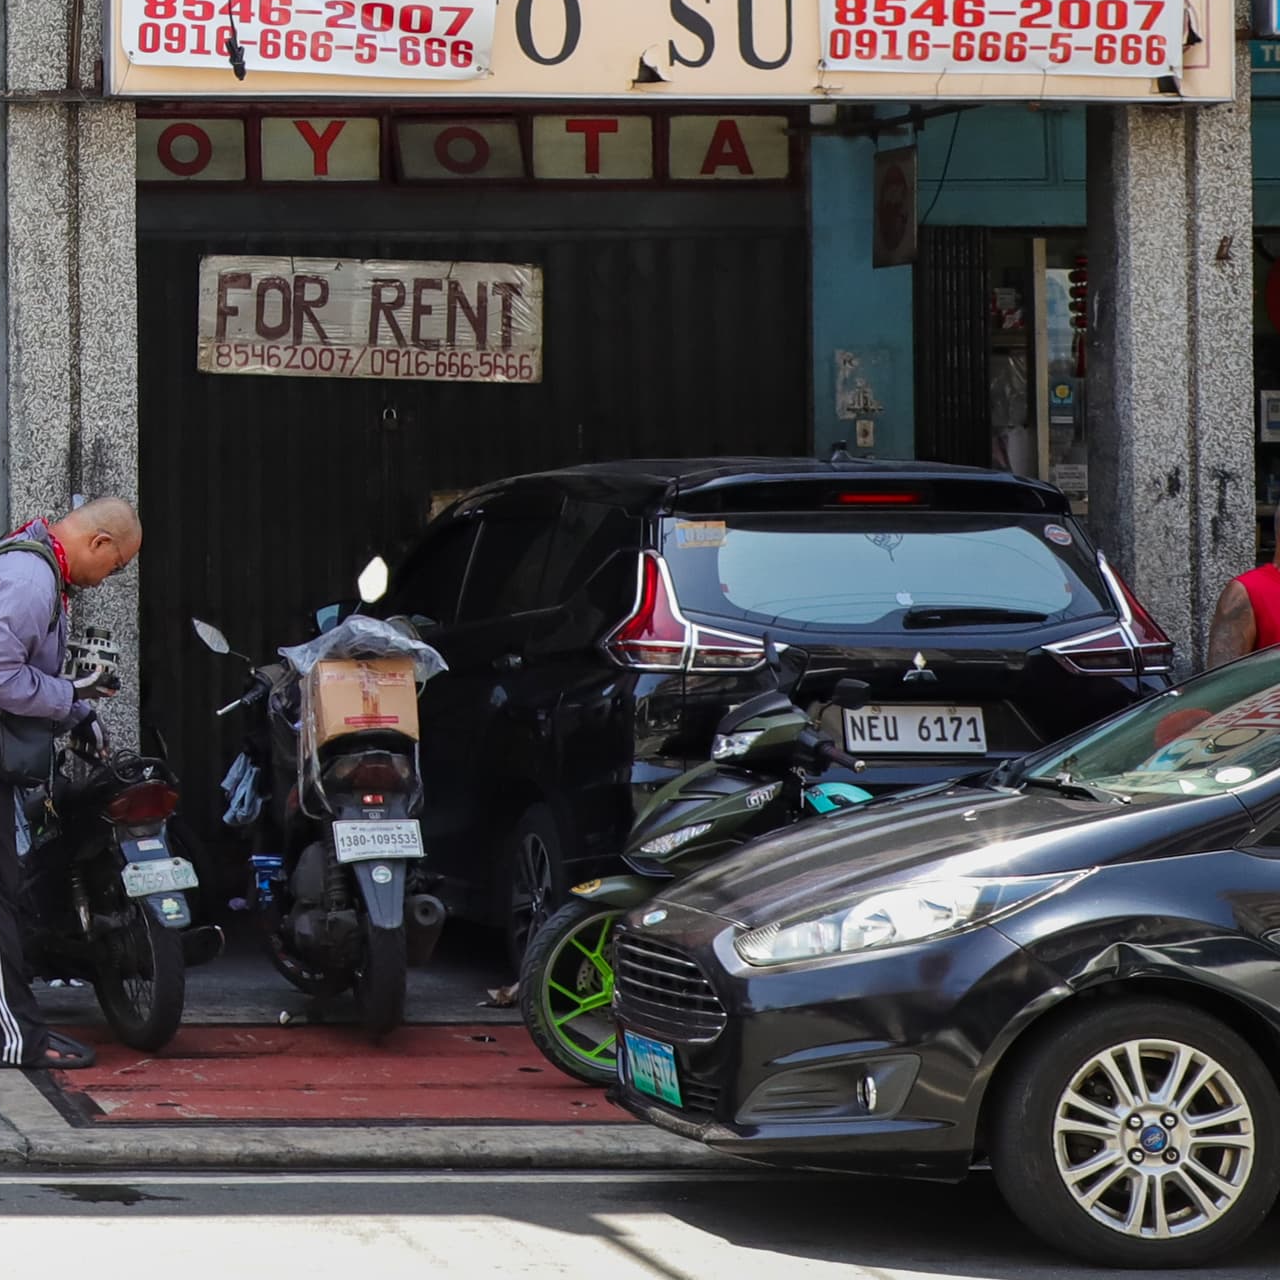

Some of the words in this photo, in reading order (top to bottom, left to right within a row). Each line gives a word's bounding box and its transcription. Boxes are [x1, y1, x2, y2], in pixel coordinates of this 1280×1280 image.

[136, 19, 474, 69] 0916-666-5-666
[829, 27, 1168, 66] 0916-666-5-666
[215, 271, 330, 347] FOR
[368, 276, 526, 354] RENT
[849, 713, 900, 742] NEU
[917, 715, 982, 744] 6171
